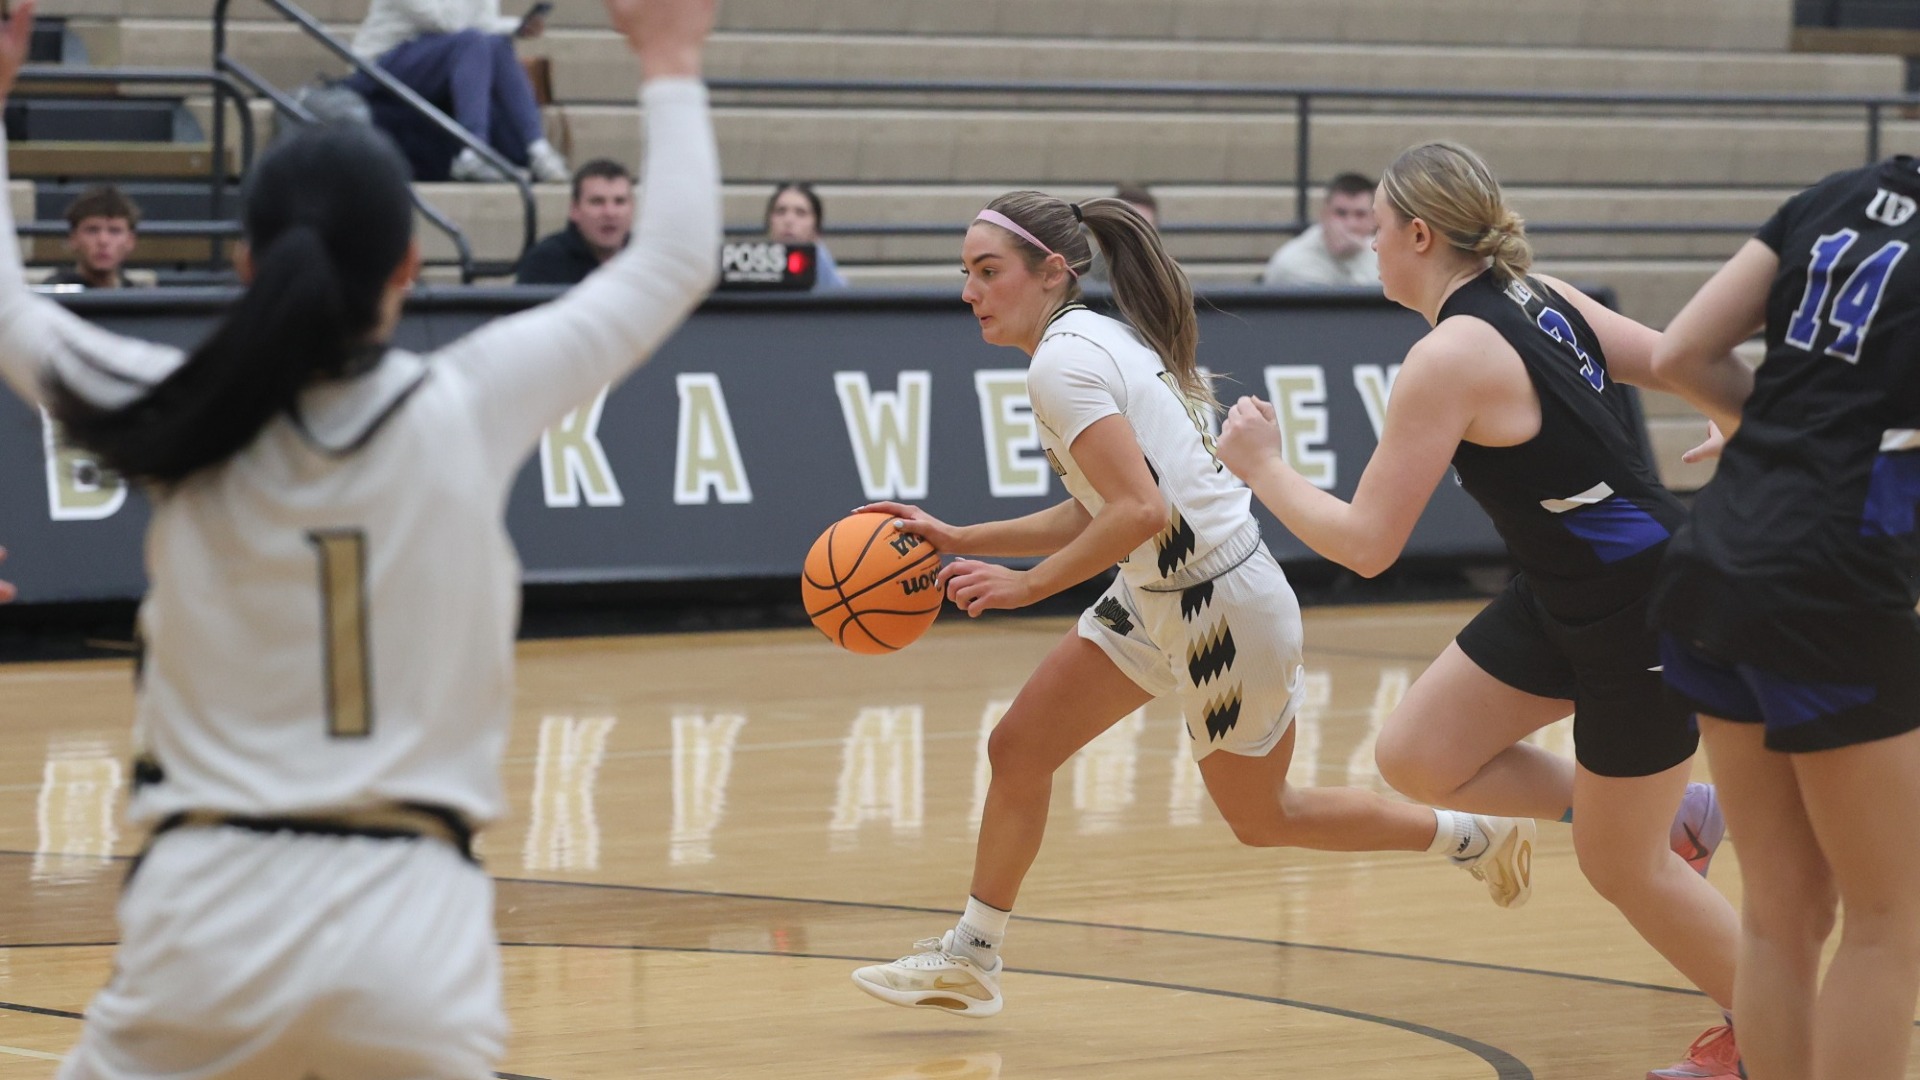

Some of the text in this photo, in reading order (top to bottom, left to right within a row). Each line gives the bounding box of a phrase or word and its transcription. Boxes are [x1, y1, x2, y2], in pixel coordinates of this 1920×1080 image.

[722, 243, 786, 272] POSS
[1784, 227, 1909, 365] 14
[1536, 305, 1604, 394] 3
[306, 529, 372, 738] 1
